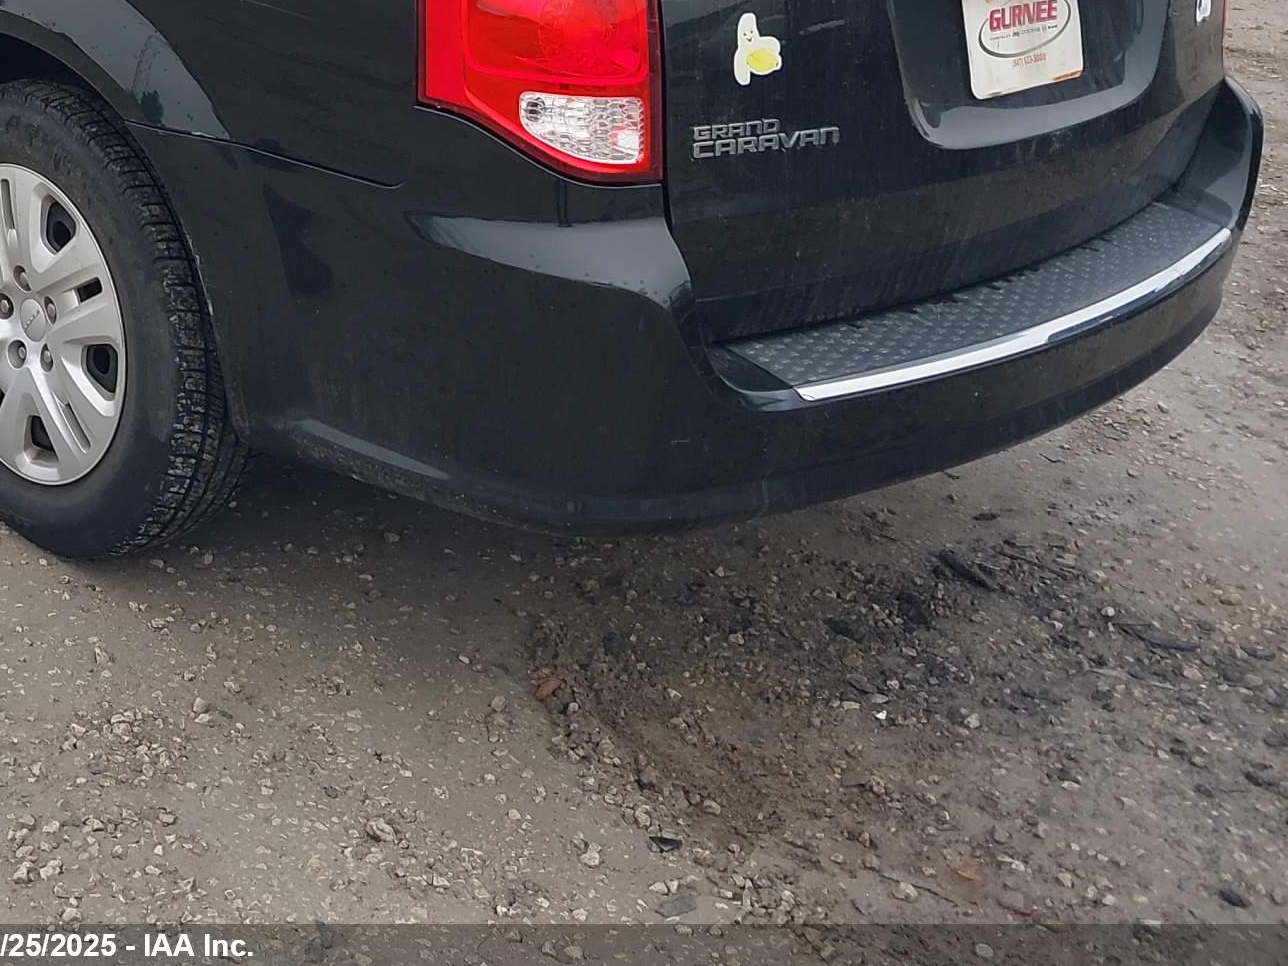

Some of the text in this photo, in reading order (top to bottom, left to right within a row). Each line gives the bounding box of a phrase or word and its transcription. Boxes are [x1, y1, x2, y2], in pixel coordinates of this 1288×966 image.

[989, 0, 1058, 32] GURNEE
[692, 126, 840, 159] CARAVAN
[693, 118, 781, 141] GRAND
